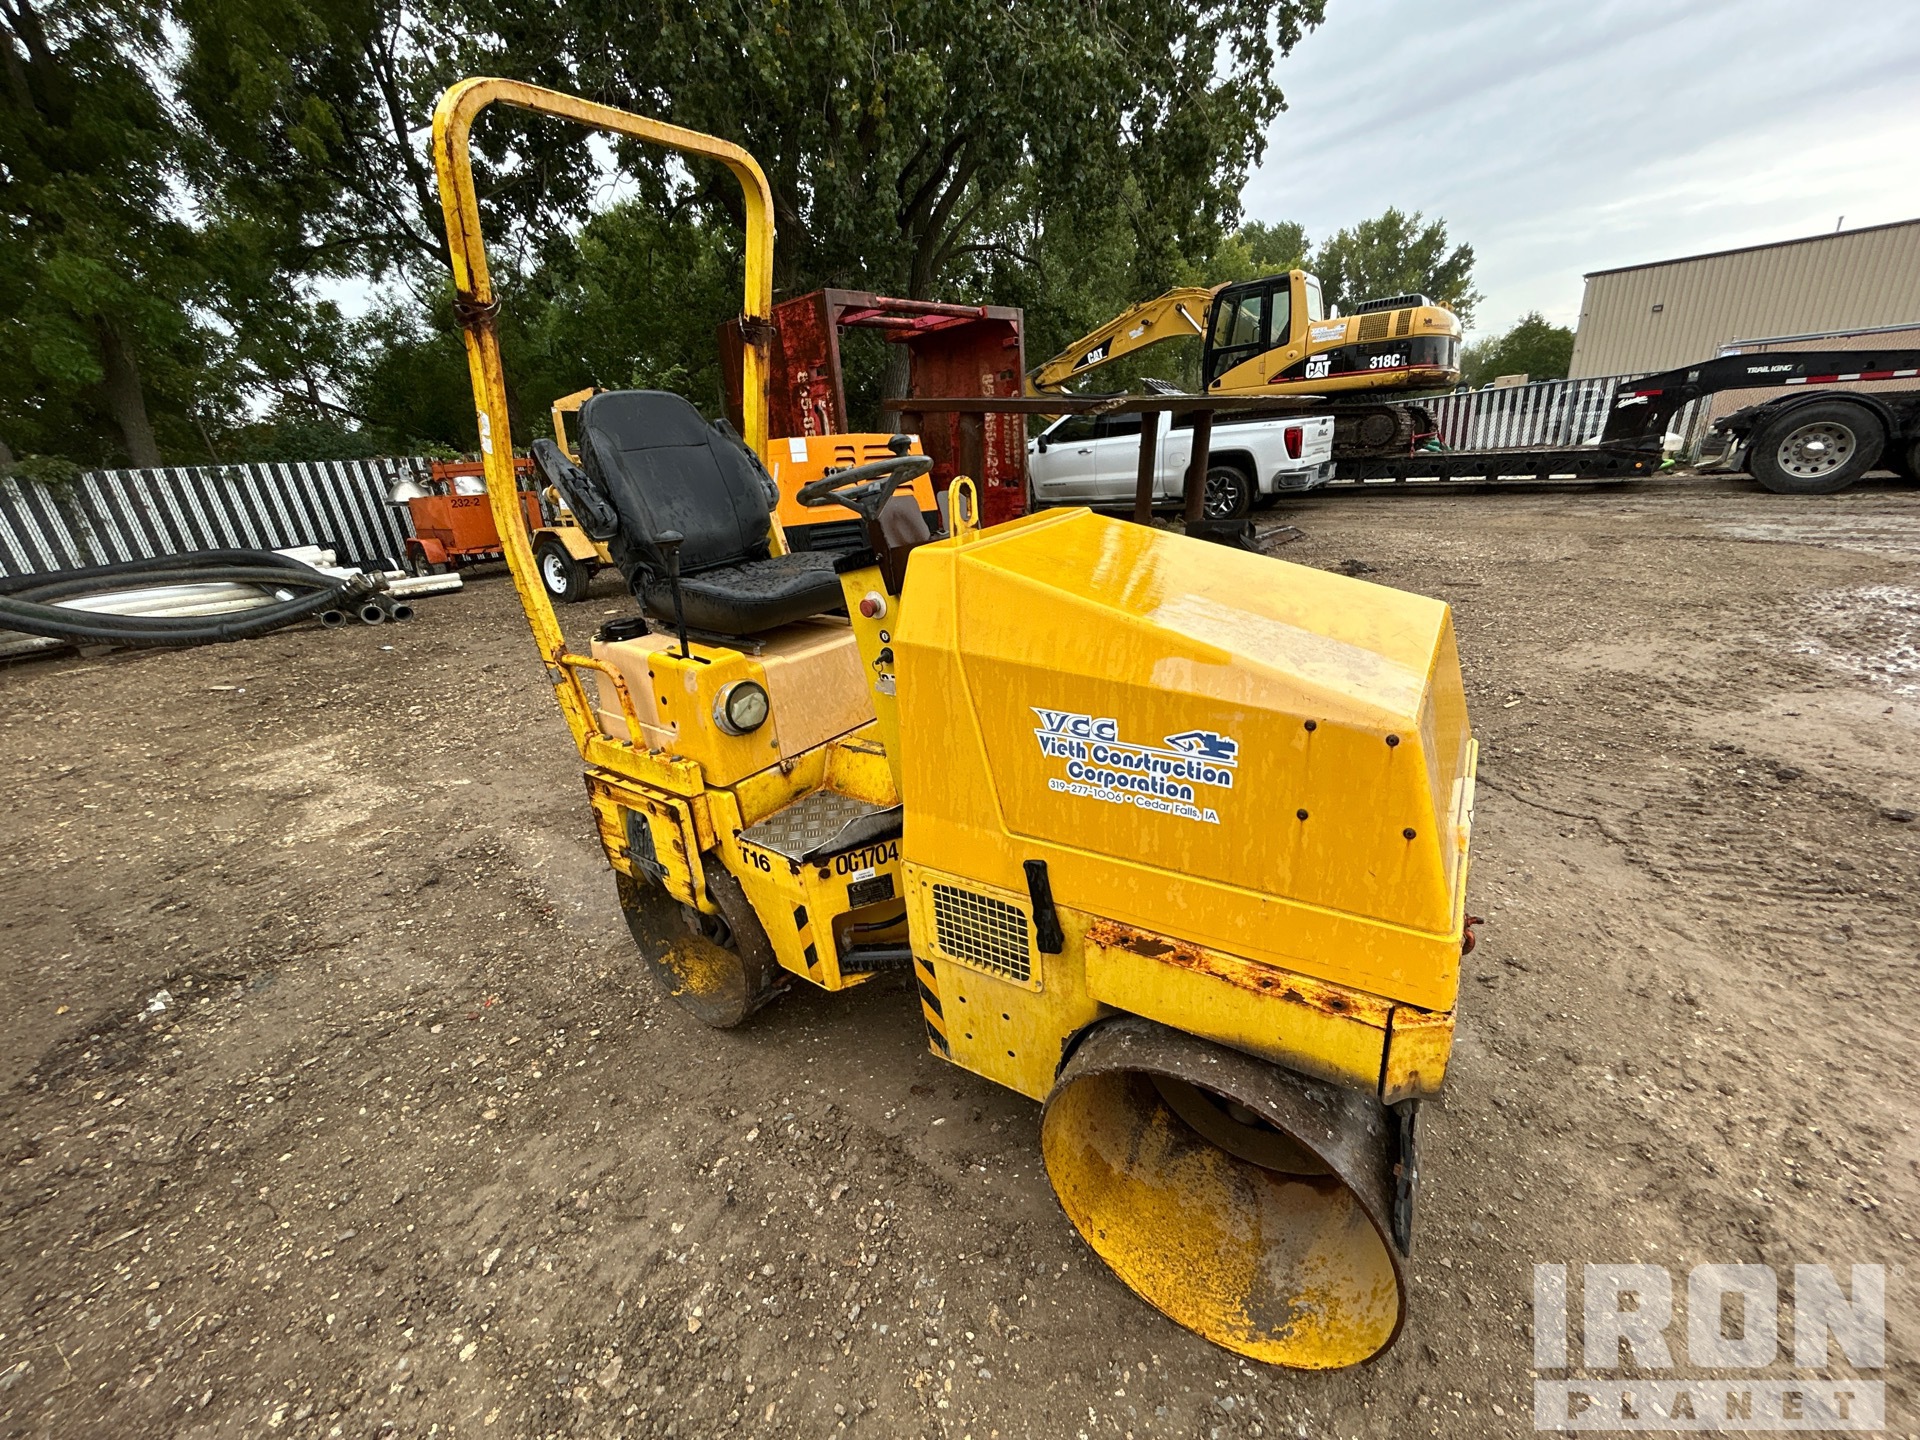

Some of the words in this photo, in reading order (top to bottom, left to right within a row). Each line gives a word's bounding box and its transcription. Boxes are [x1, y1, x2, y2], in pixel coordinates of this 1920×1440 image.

[1087, 347, 1103, 364] CAT
[1369, 353, 1400, 369] 318C
[1305, 360, 1332, 379] CAT
[1746, 365, 1770, 374] TRAIL
[1770, 364, 1794, 372] KING
[451, 497, 481, 508] 232-2
[1036, 709, 1116, 742] VCC
[1038, 735, 1087, 760] Vieth
[1092, 744, 1231, 786] Construction
[1067, 761, 1192, 801] Corporation
[1049, 779, 1122, 802] 319-277-1006
[1136, 796, 1170, 812] Cedar
[1175, 804, 1201, 819] Falls,
[1204, 810, 1217, 822] IA
